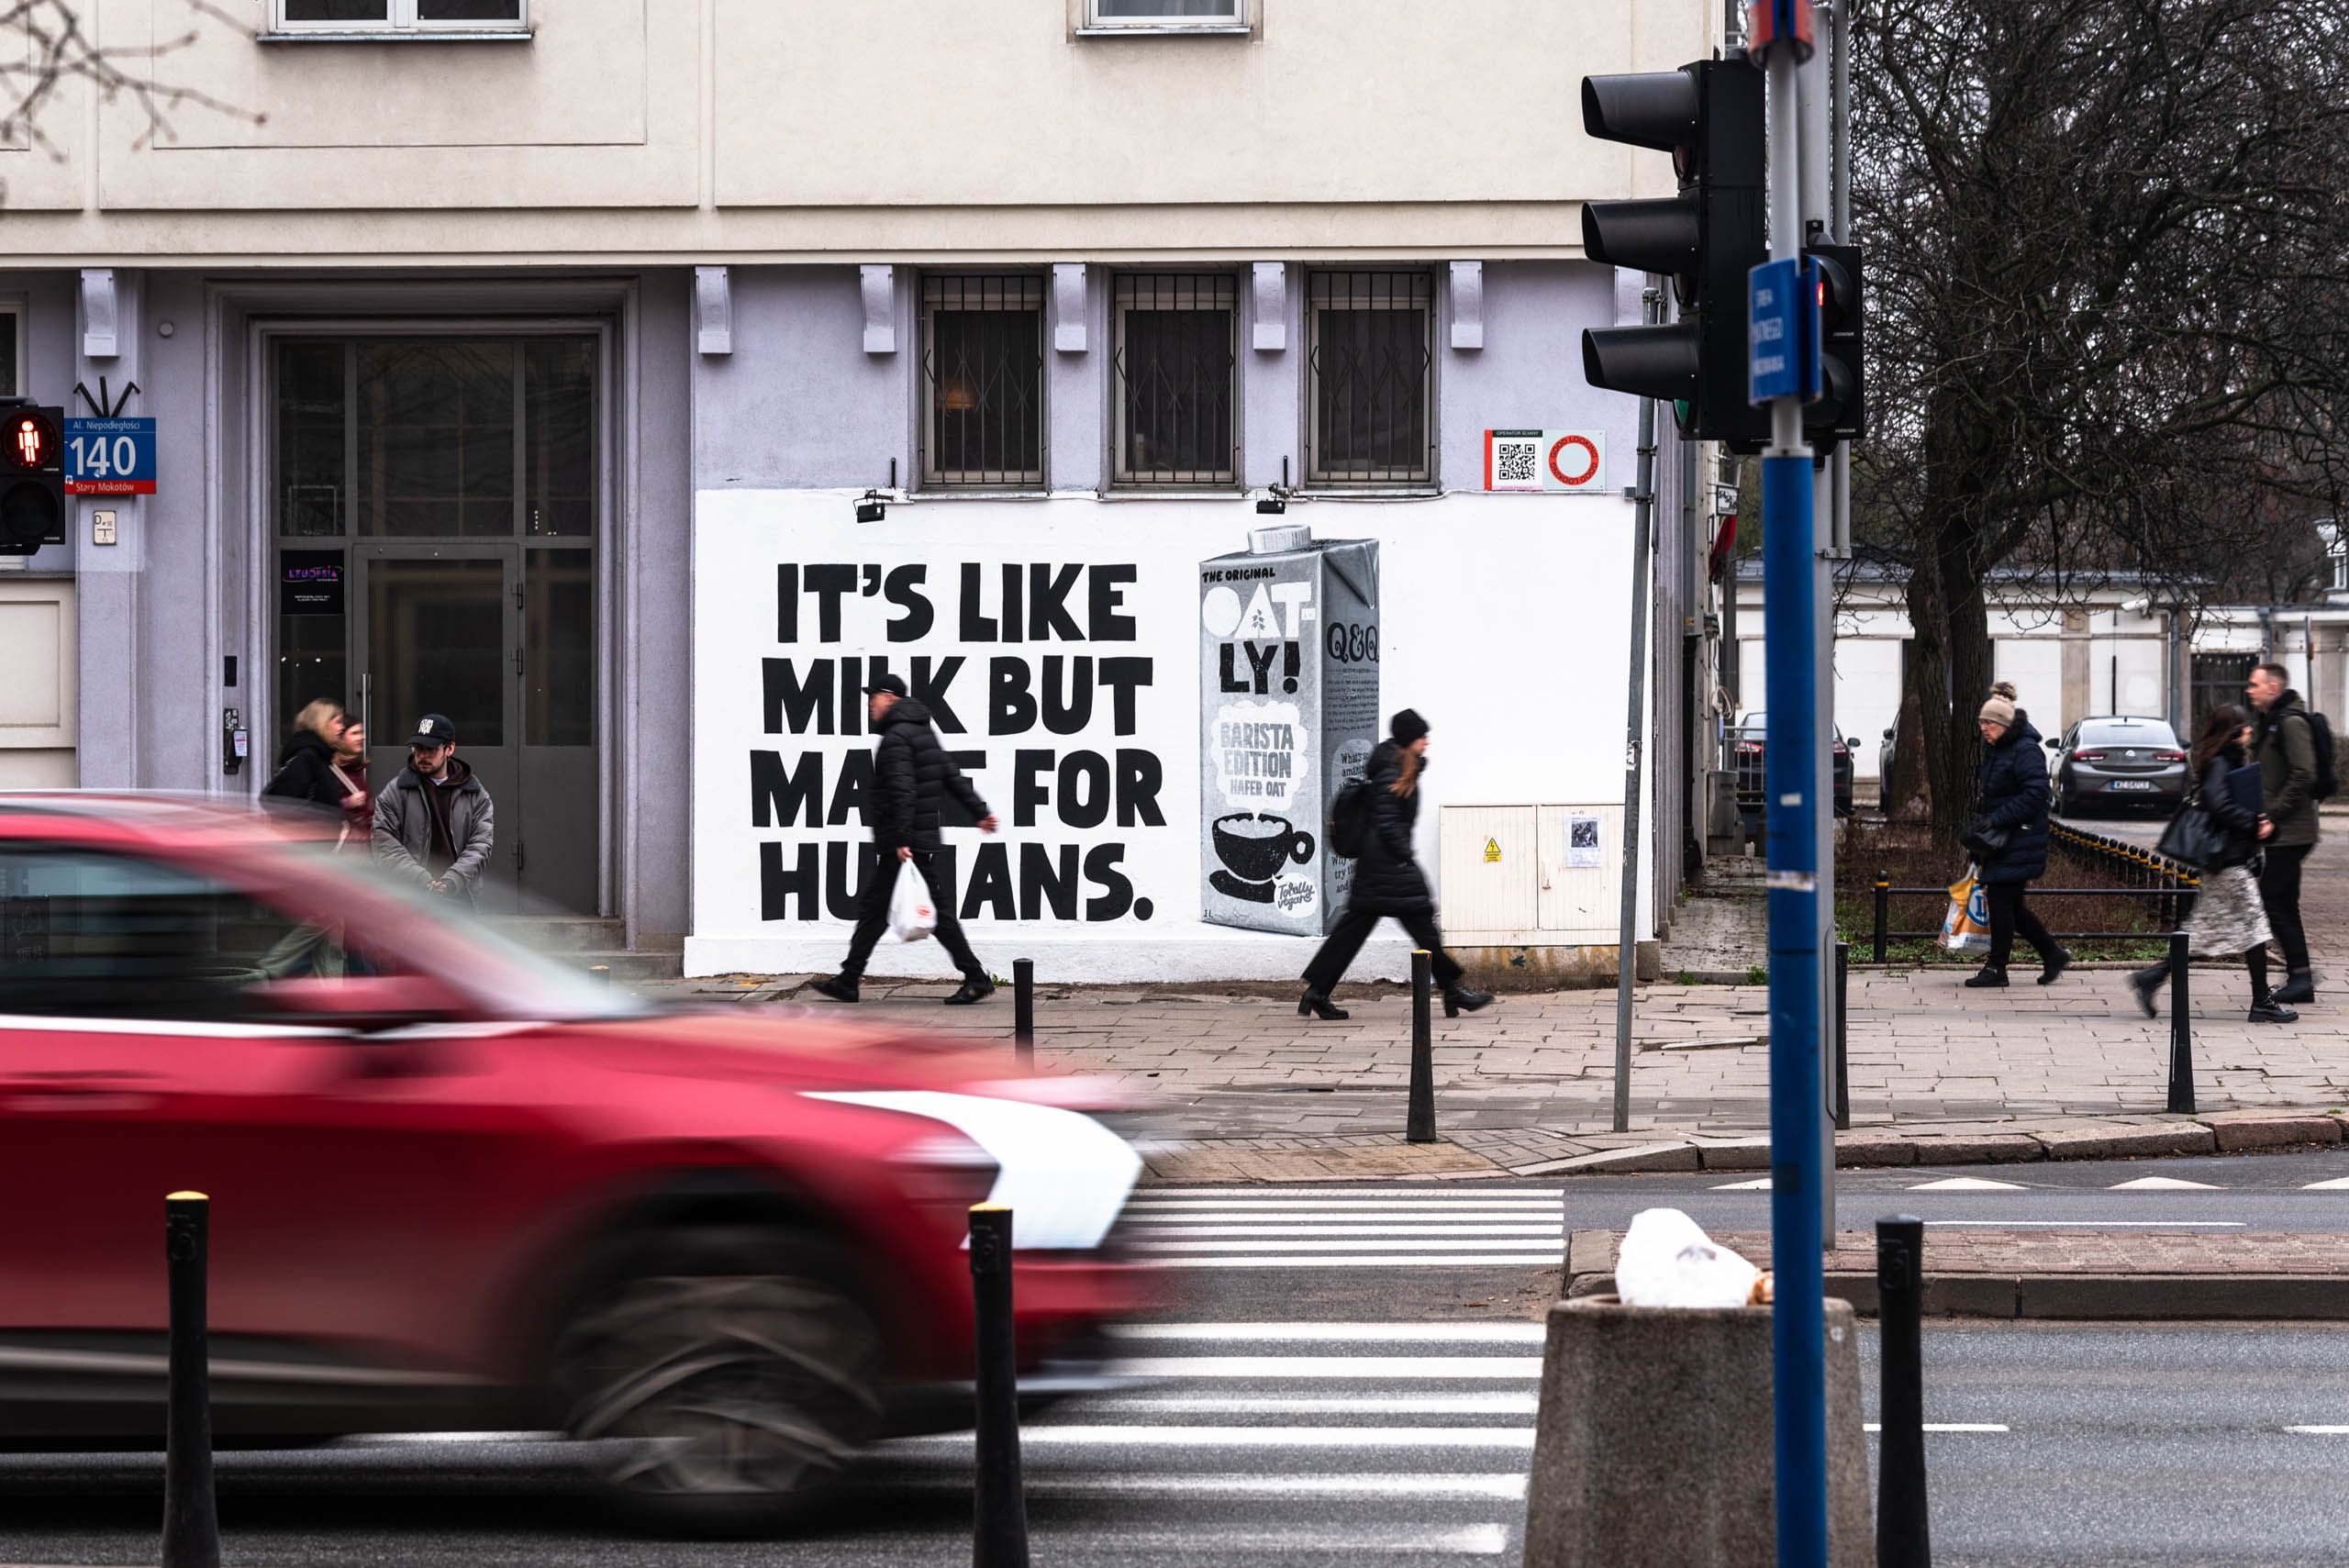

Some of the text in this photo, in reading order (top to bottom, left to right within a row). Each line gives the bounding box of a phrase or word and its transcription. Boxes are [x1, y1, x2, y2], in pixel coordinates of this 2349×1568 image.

[73, 420, 140, 431] Al. Niepodległości
[70, 436, 136, 475] 140
[1570, 435, 1598, 459] LOOKING
[76, 483, 134, 494] Stary Mokotów
[1202, 567, 1276, 583] THE ORIGINAL
[777, 562, 1137, 643] IT'S LIKE
[1219, 640, 1301, 695] LY!
[988, 656, 1152, 736] BUT
[1220, 722, 1294, 751] BARISTA
[1224, 751, 1291, 778] EDITION
[1341, 752, 1362, 764] What's
[1342, 765, 1365, 777] amazin
[750, 750, 1166, 828] MAE FOR
[1230, 779, 1286, 797] HAFER OAT
[1334, 869, 1346, 880] try
[1278, 881, 1315, 899] Totally
[1277, 895, 1312, 911] vegan
